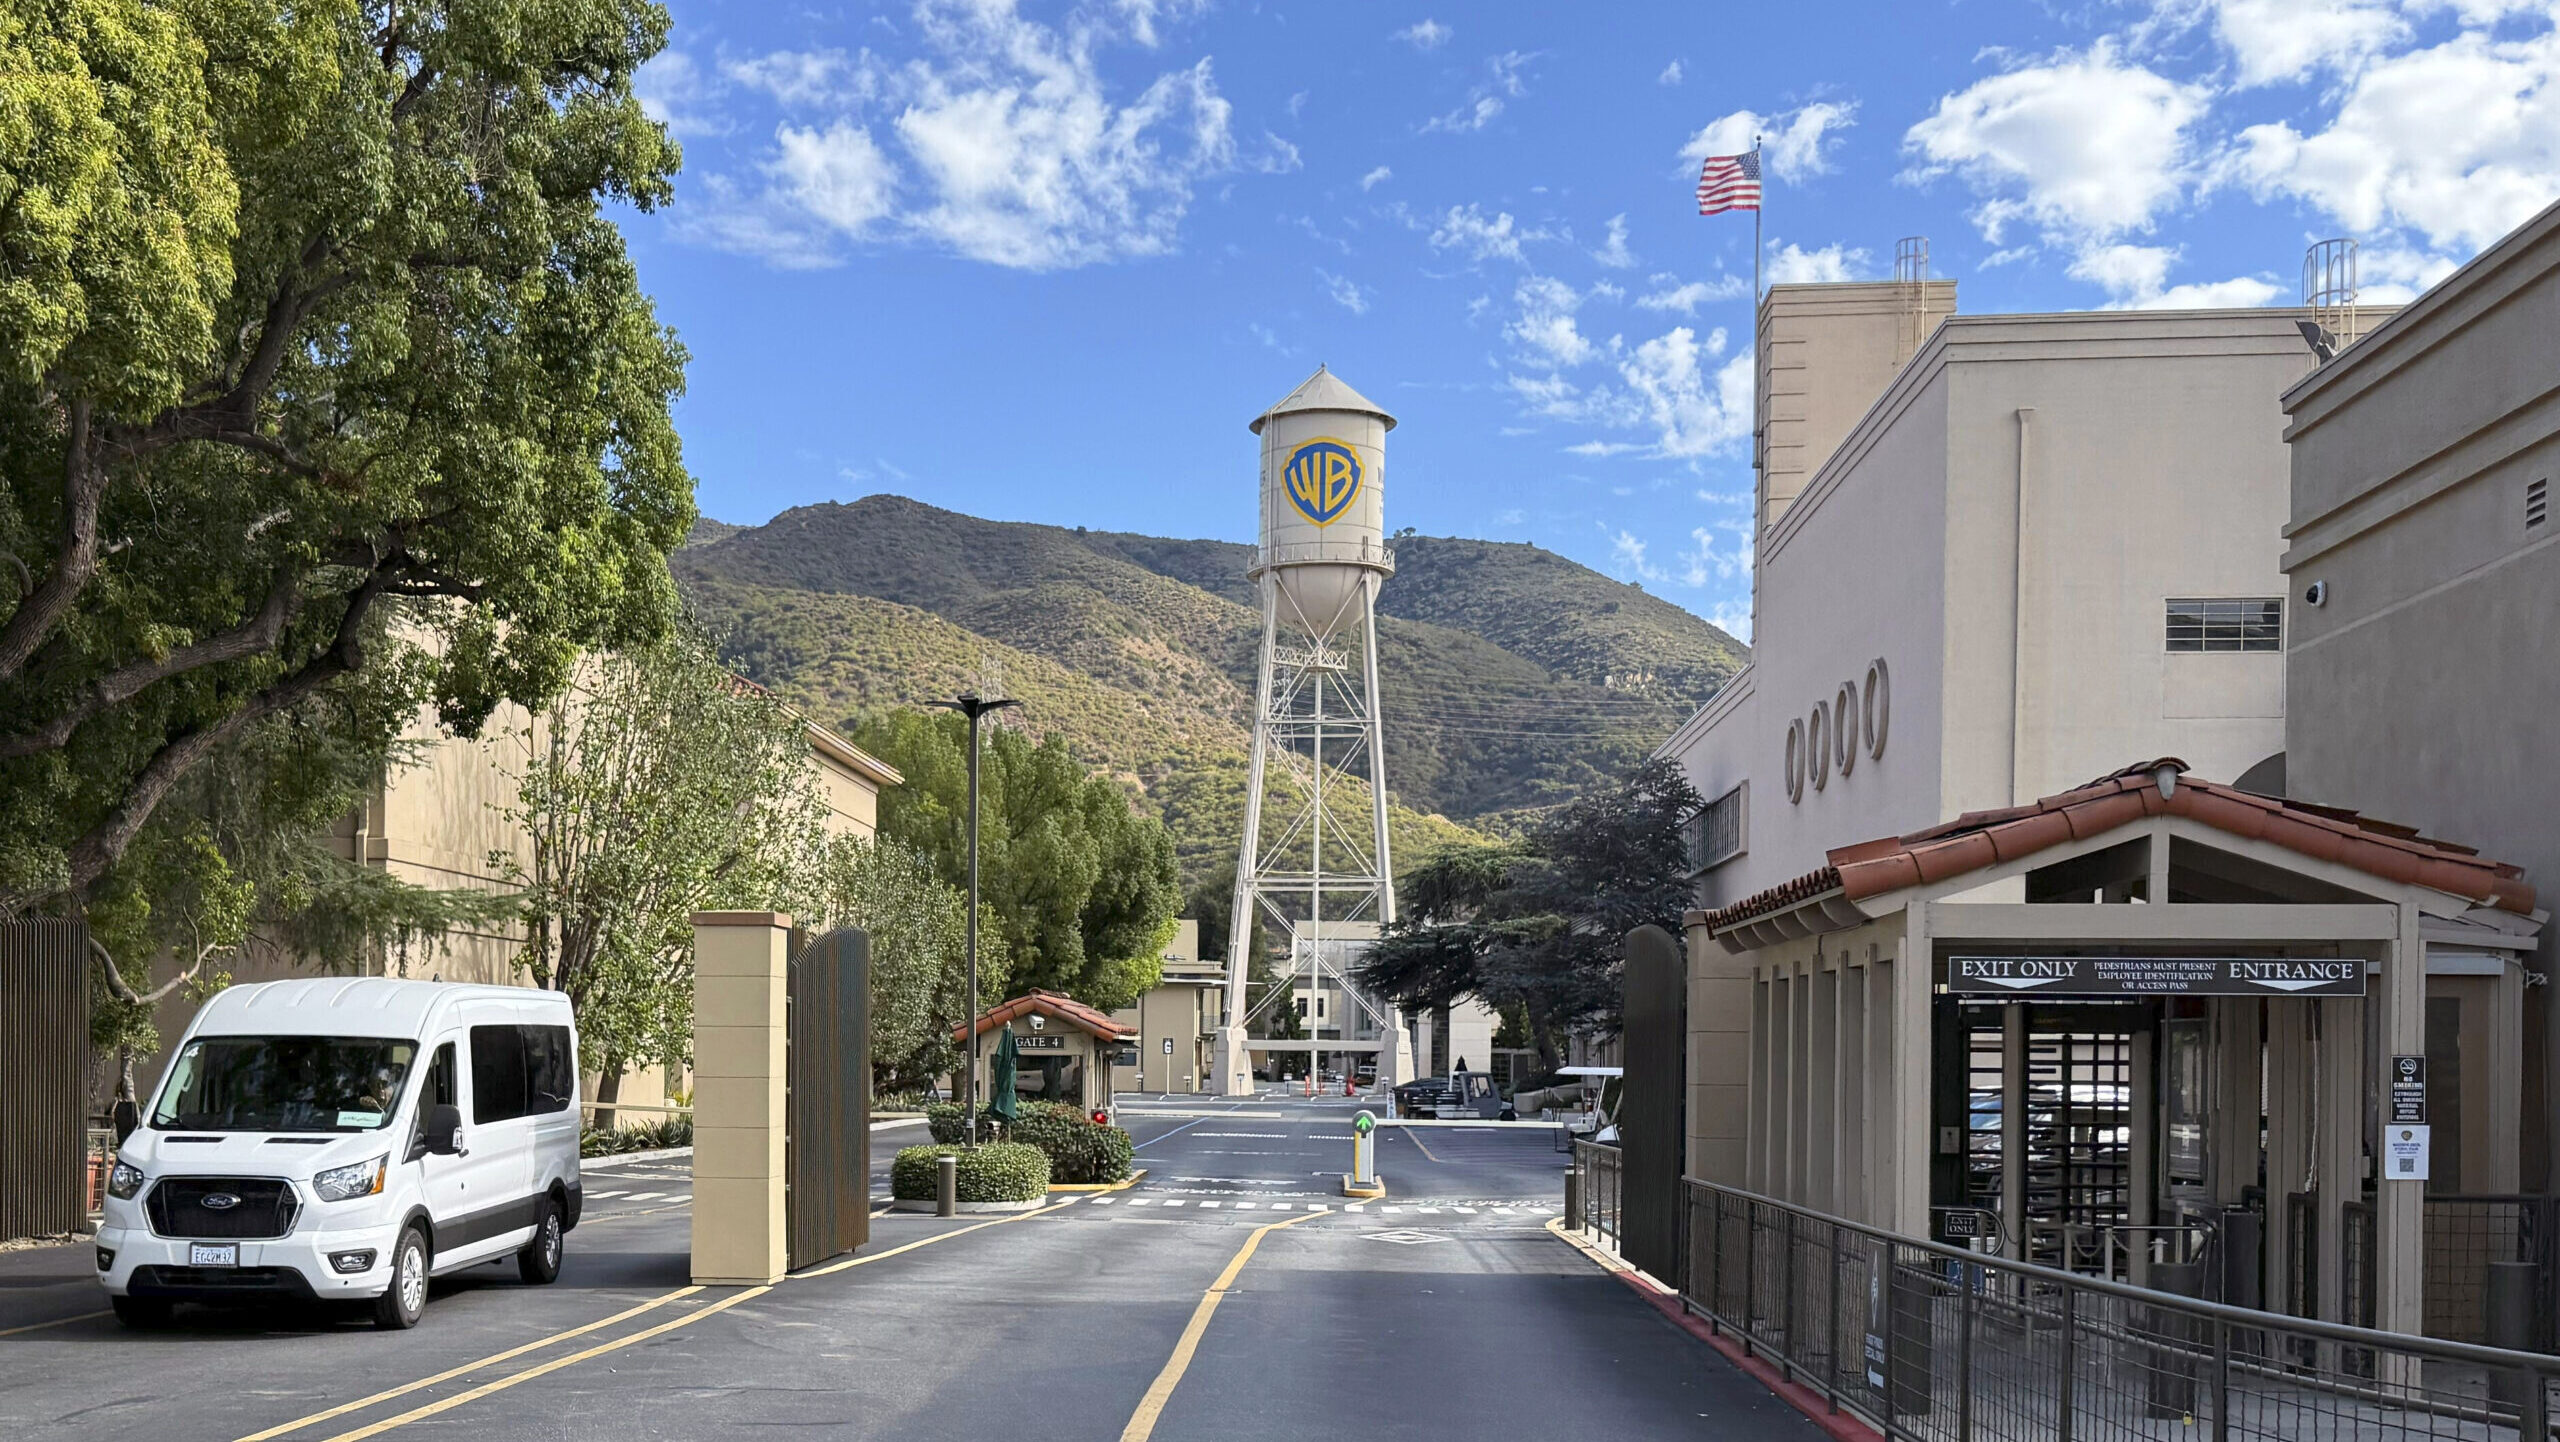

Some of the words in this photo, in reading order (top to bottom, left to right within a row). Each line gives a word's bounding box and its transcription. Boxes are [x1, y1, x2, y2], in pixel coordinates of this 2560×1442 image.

[1289, 451, 1353, 514] WB
[1961, 960, 2013, 977] EXIT
[2020, 960, 2078, 978] ONLY
[2094, 962, 2151, 970] PEDESTRIANS
[2153, 962, 2177, 970] MUST
[2180, 962, 2217, 971] PRESENT
[2229, 962, 2354, 979] ENTRANCE
[2098, 971, 2142, 980] EMPLOYEE
[2144, 972, 2213, 980] IDENTIFICATION
[2121, 981, 2135, 990] OR
[2136, 981, 2168, 990] ACCESS
[2169, 981, 2189, 990] PASS
[1015, 1037, 1046, 1047] GATE
[1052, 1037, 1058, 1047] 4
[1951, 1217, 1975, 1225] EXIT
[1950, 1225, 1975, 1233] ONLY
